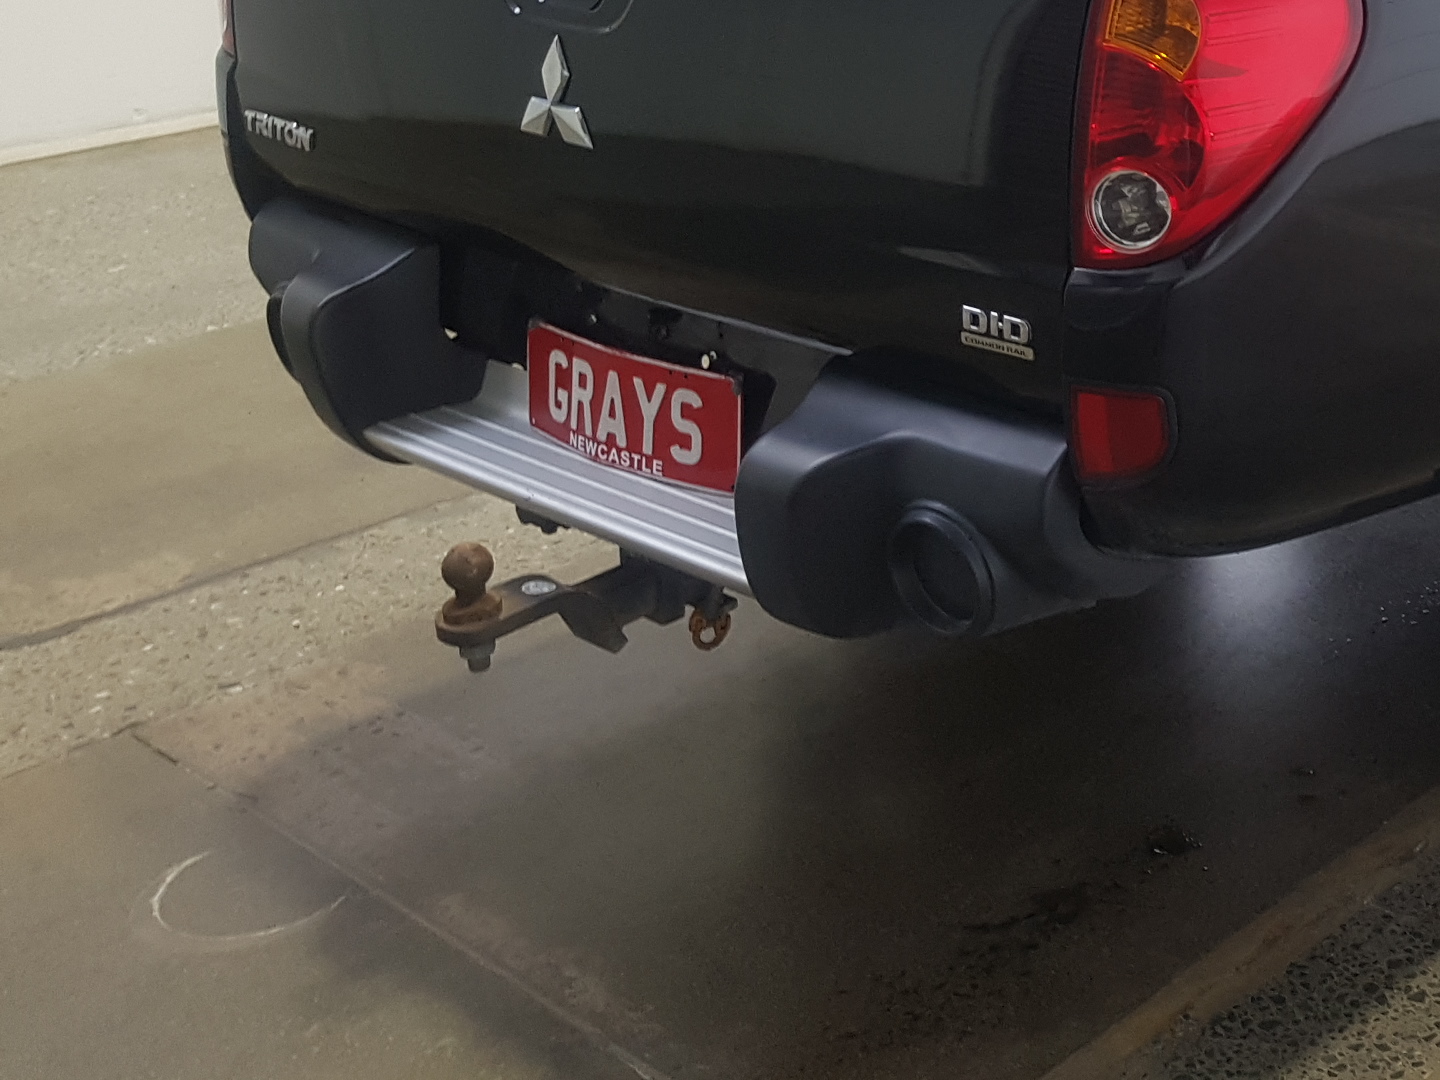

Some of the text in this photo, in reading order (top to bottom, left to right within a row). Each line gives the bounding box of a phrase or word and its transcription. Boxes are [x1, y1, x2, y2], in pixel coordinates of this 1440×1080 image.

[244, 109, 314, 152] TRITON
[548, 348, 703, 466] GRAYS
[569, 430, 664, 477] NEWCASTLE
